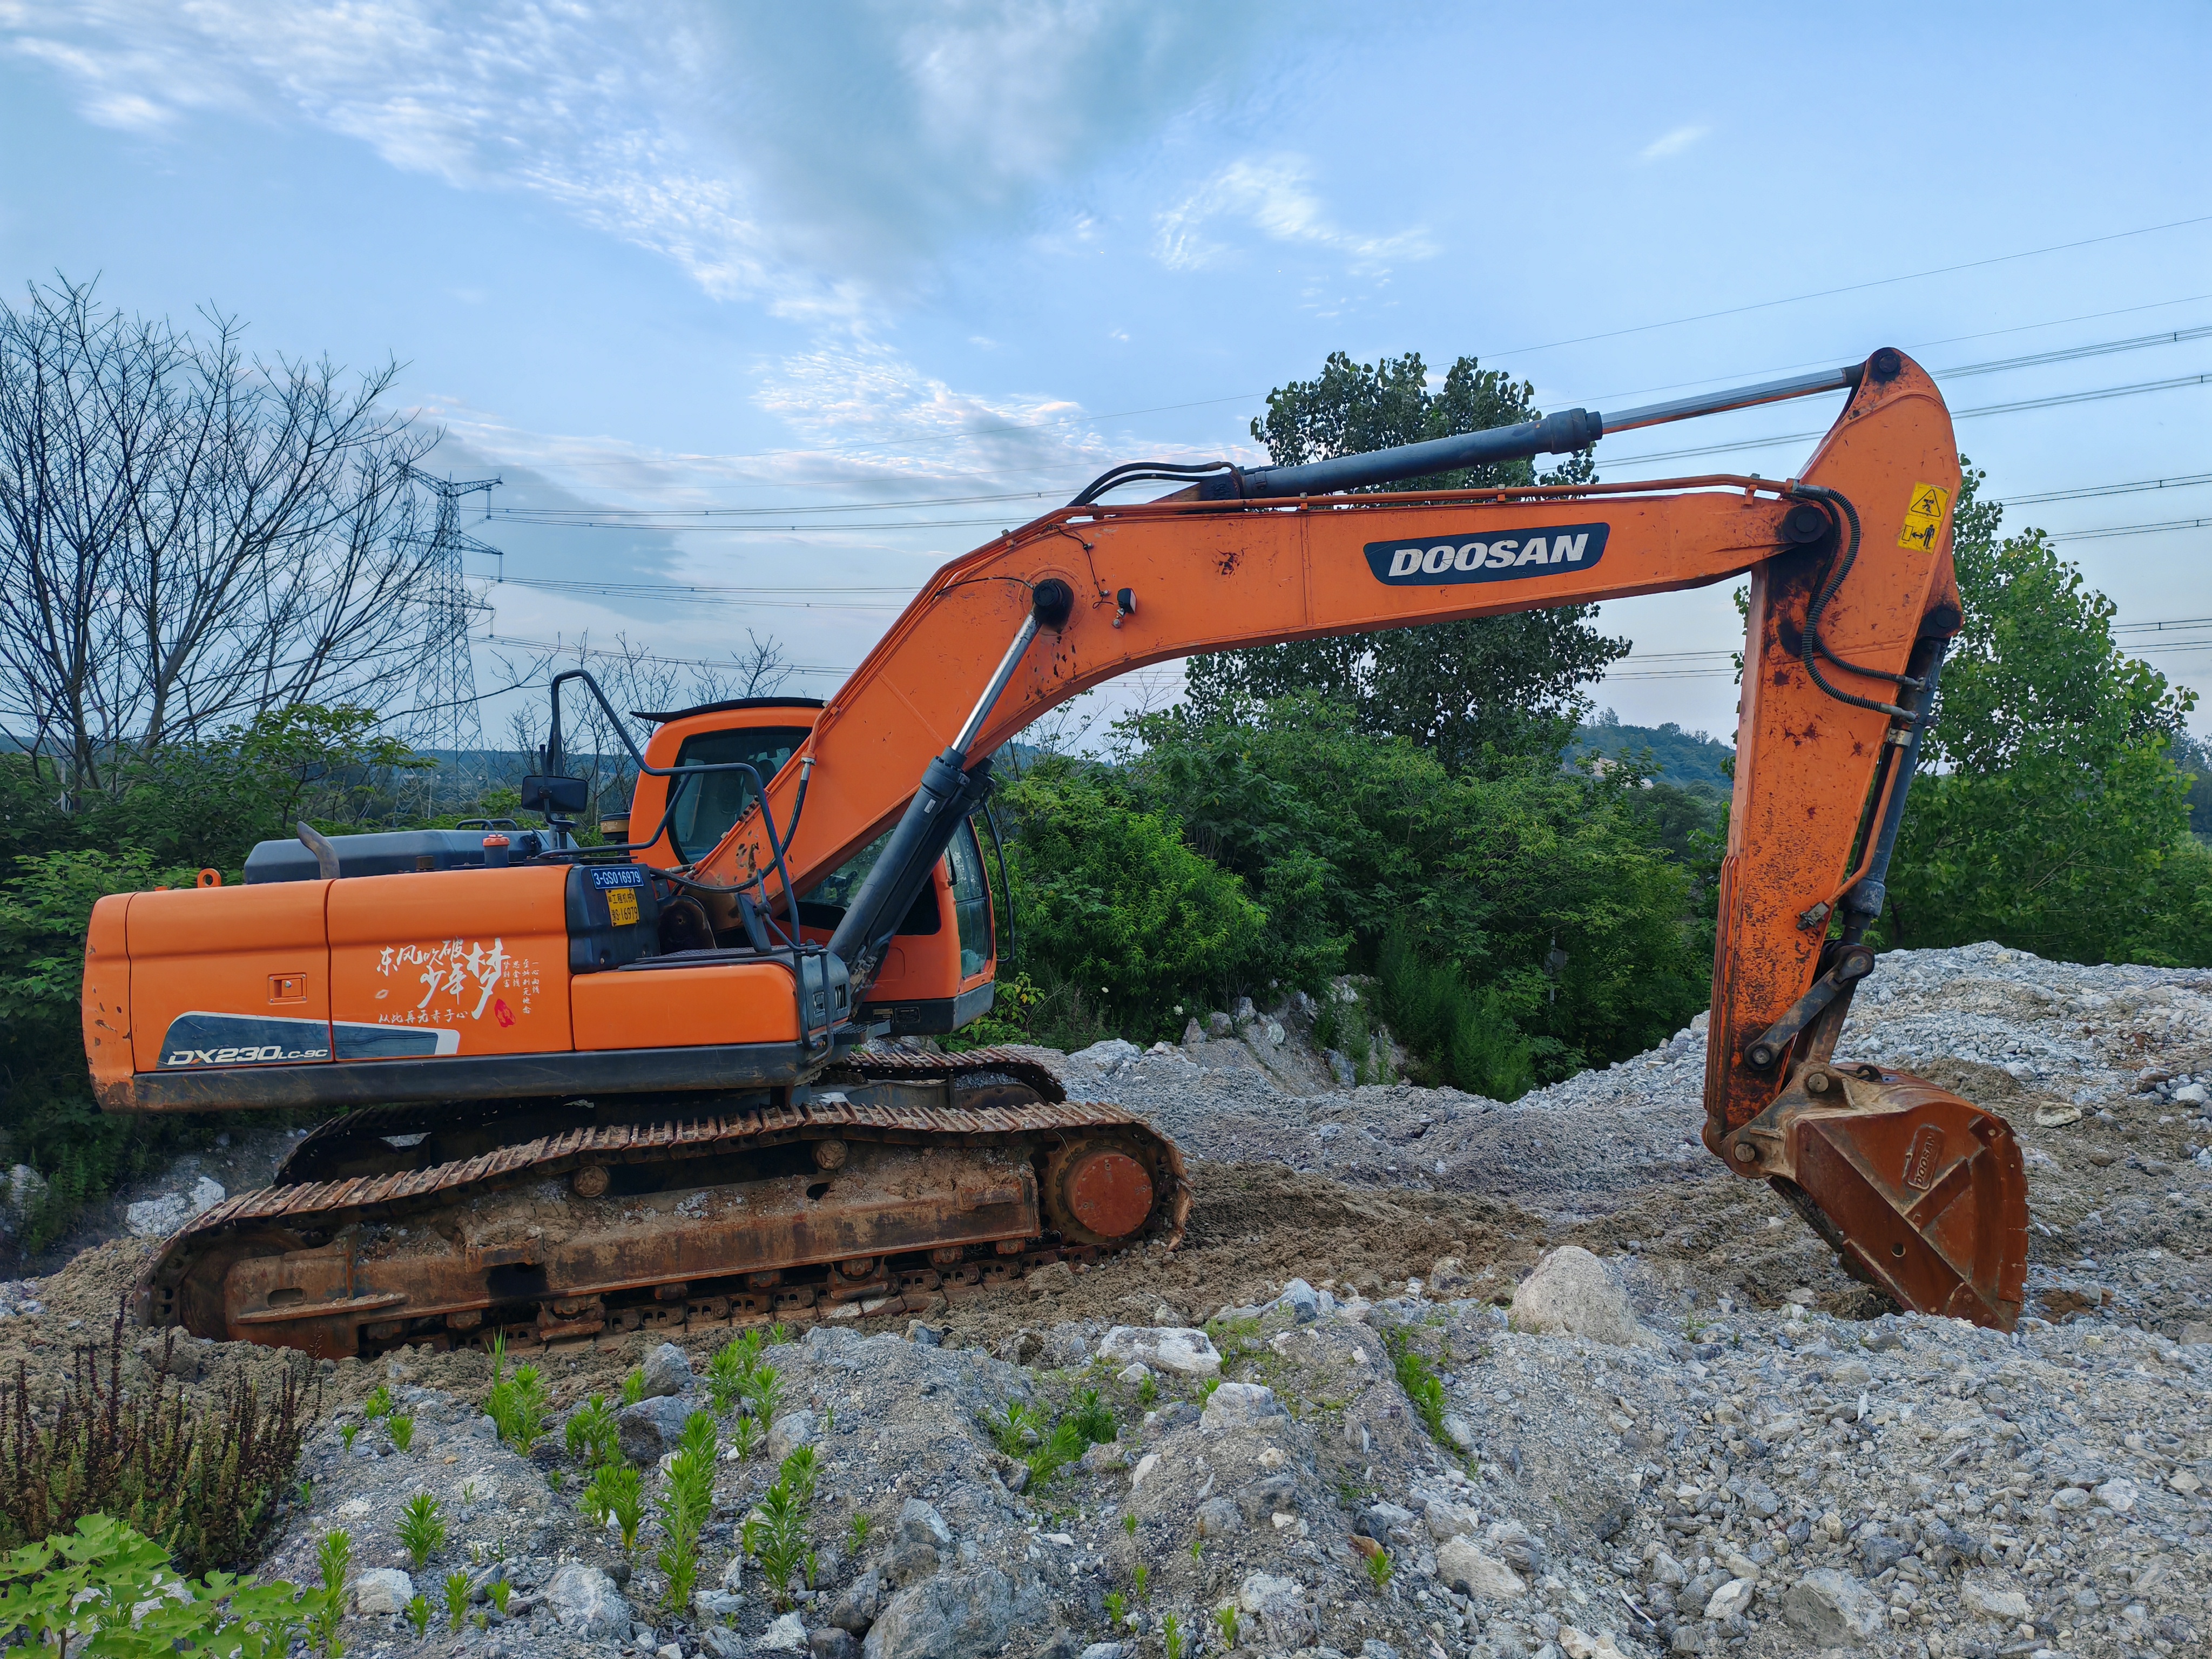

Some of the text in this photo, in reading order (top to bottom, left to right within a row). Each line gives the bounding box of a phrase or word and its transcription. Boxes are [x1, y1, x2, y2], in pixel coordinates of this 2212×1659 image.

[1388, 534, 1589, 577] DOOSAN
[594, 871, 641, 885] 3-GS016979
[611, 893, 632, 903] 工程机械
[1914, 1132, 1935, 1186] DOOSAN
